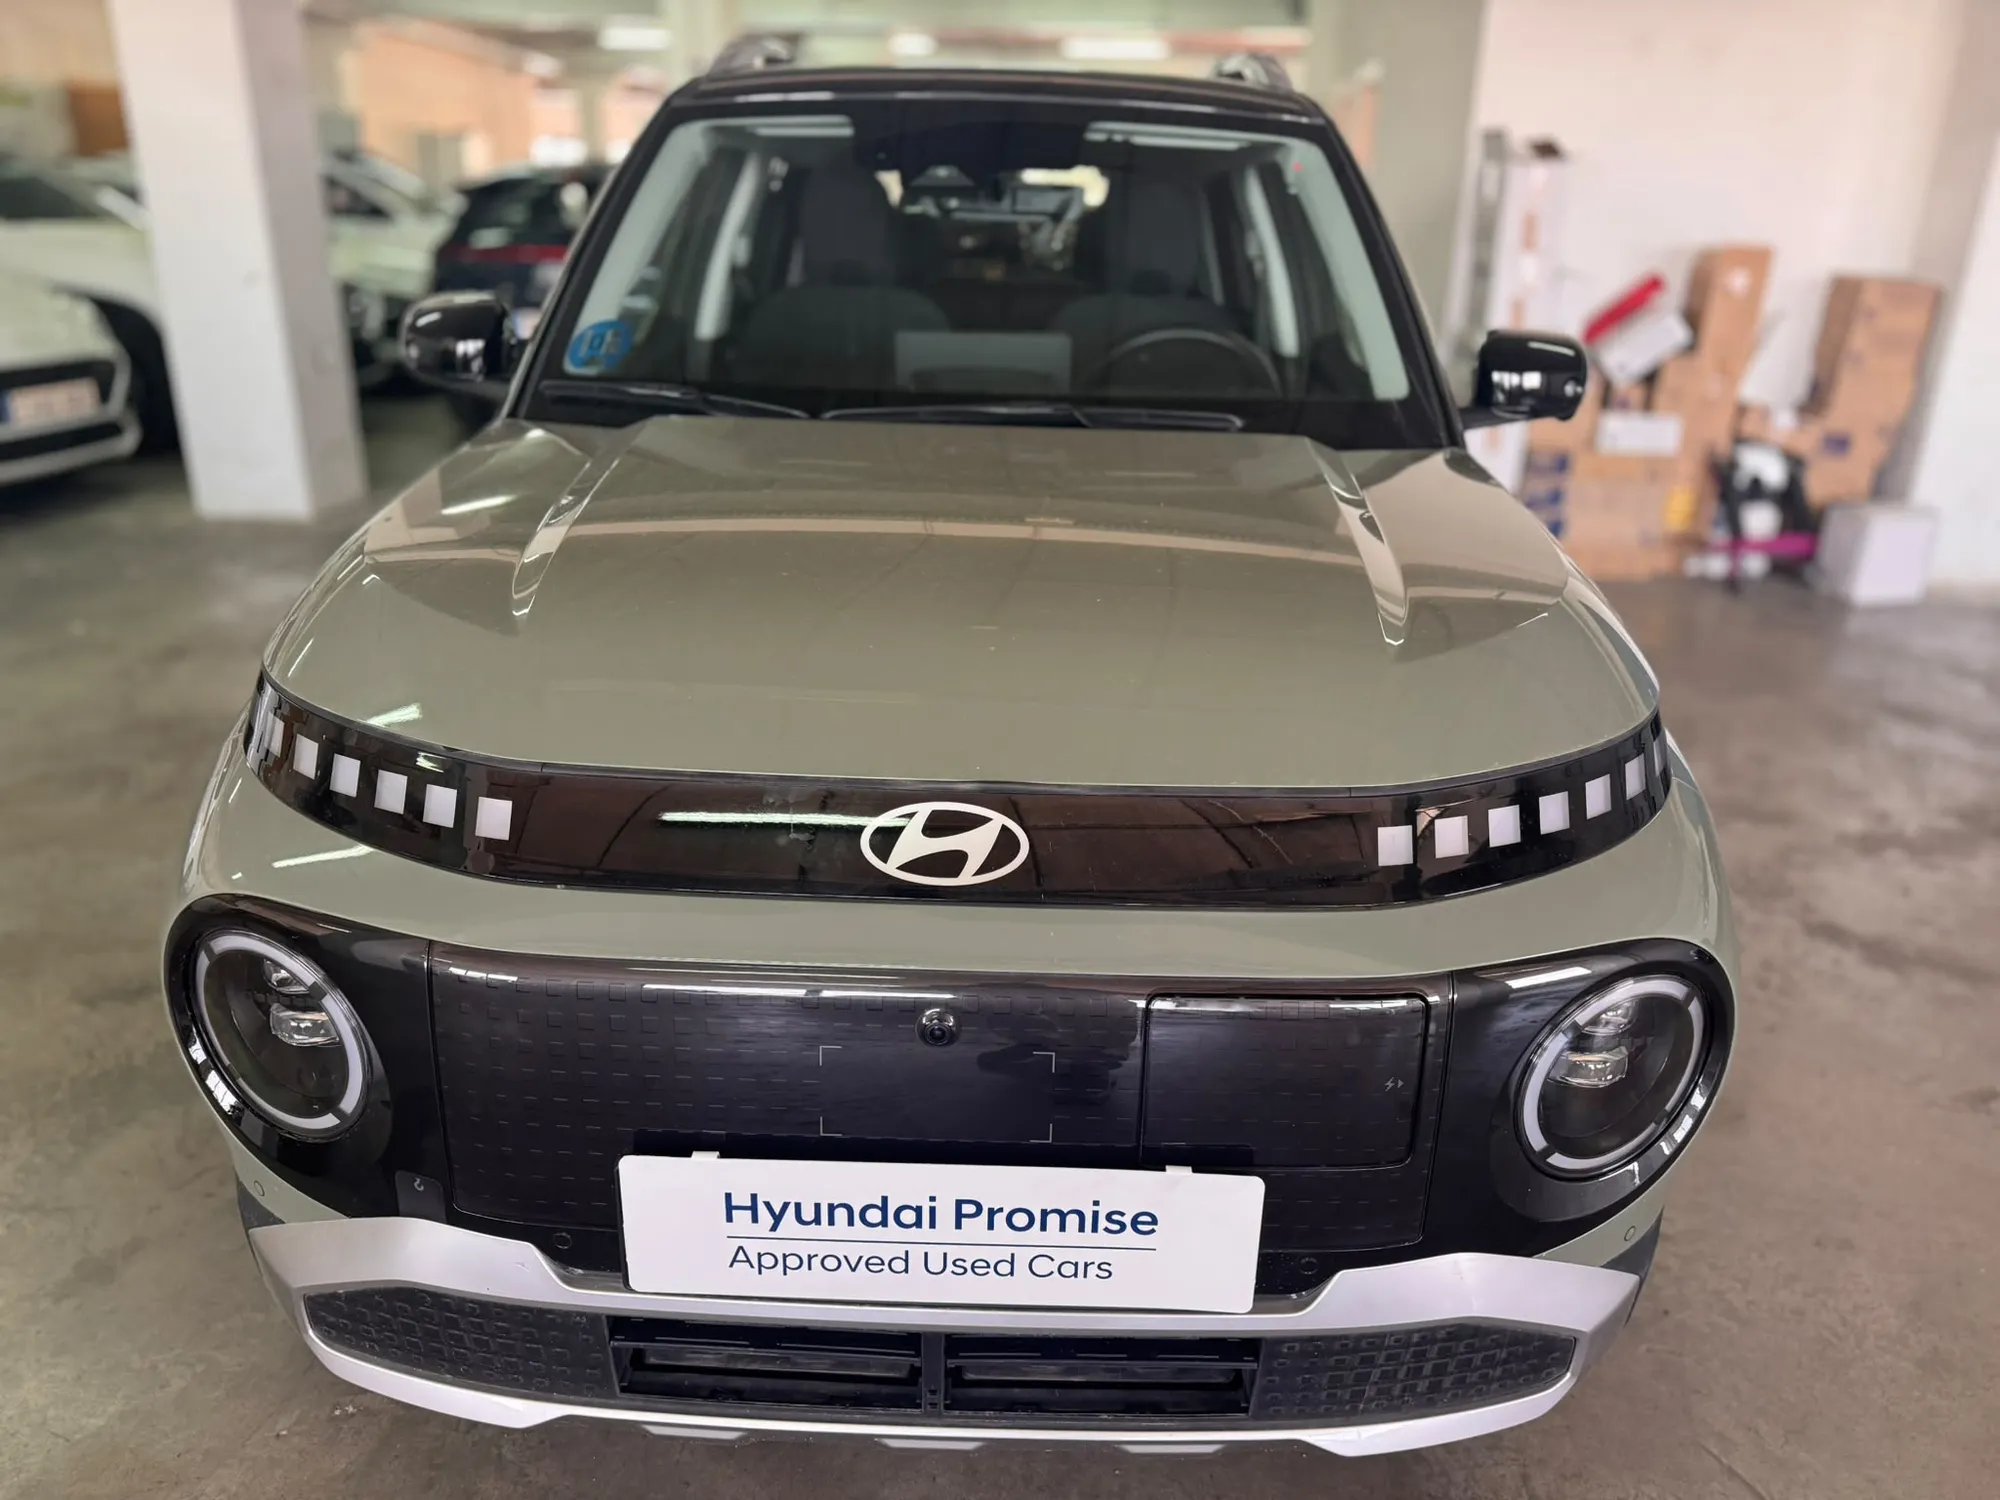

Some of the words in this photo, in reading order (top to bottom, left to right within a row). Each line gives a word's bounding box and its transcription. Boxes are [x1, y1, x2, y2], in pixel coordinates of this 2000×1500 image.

[724, 1192, 937, 1233] Hyundai
[954, 1198, 1159, 1236] Promise
[728, 1245, 909, 1277] Approved
[923, 1251, 1016, 1277] Used
[1027, 1254, 1113, 1280] Cars
